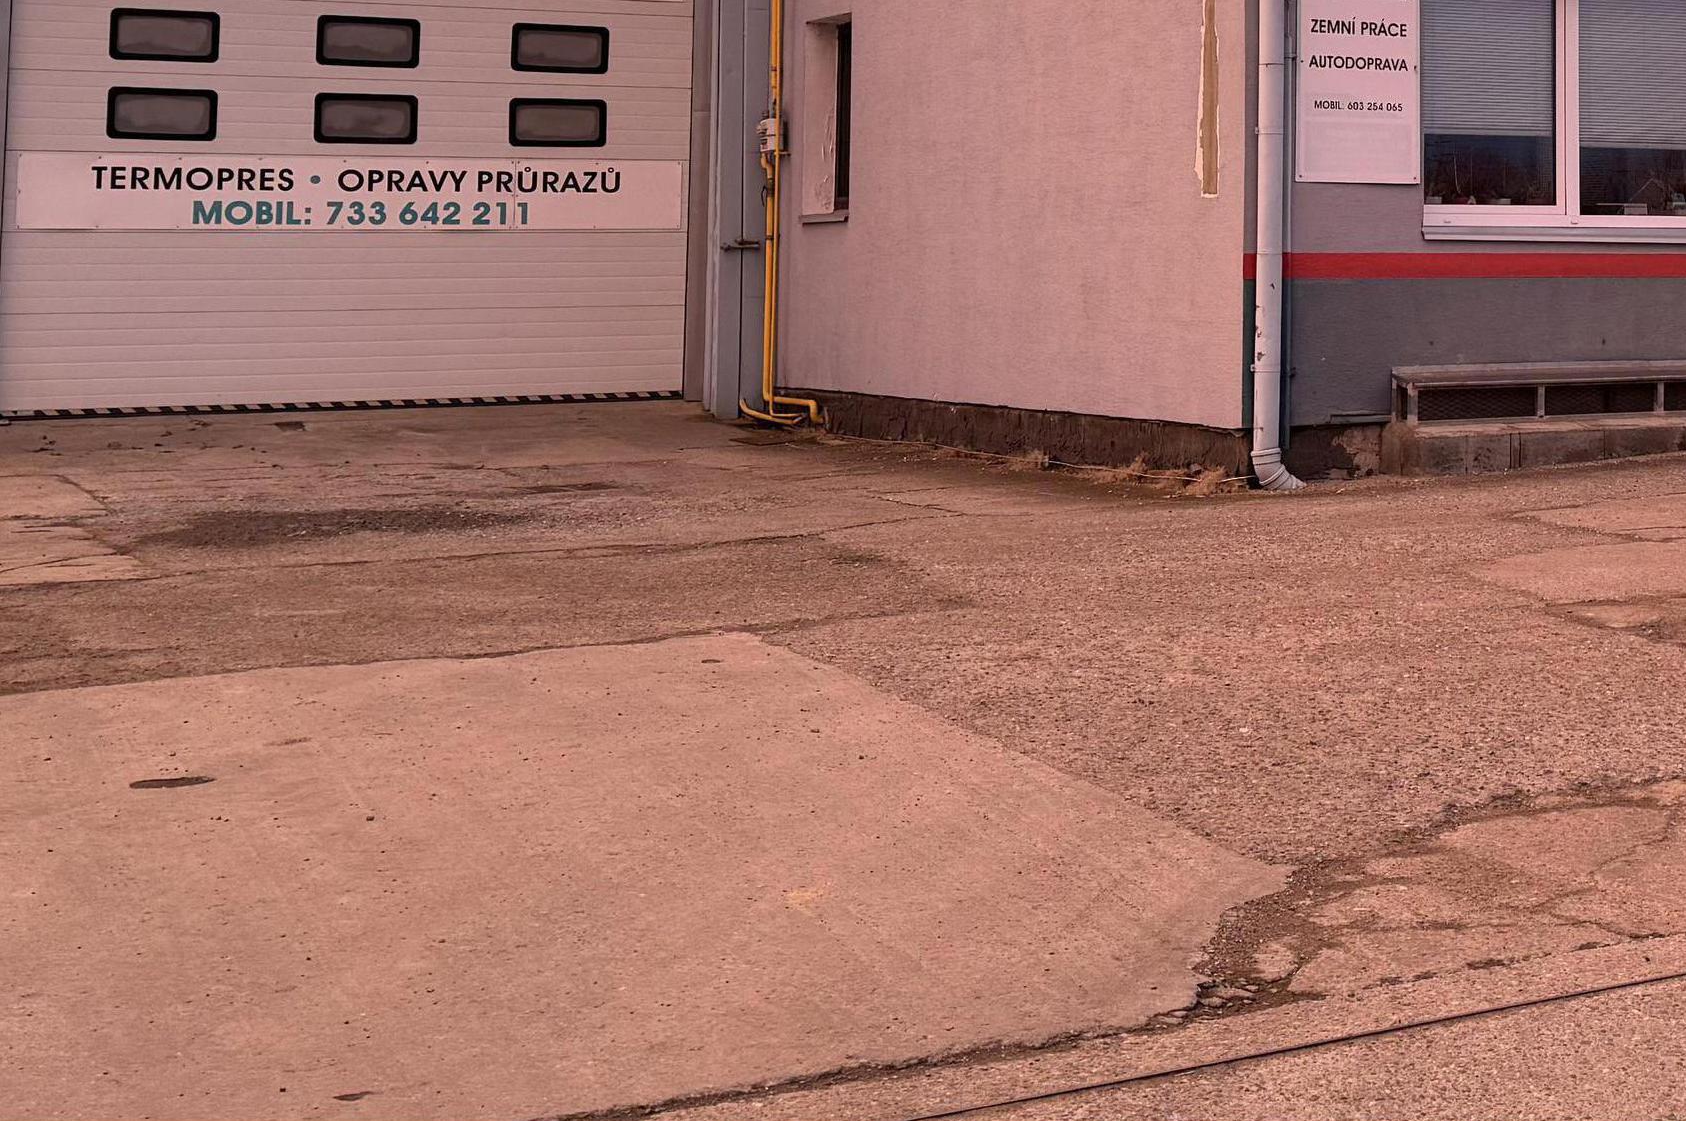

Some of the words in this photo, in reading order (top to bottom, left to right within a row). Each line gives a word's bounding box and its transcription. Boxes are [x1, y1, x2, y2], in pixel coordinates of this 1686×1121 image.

[1310, 16, 1357, 35] ZEMNÍ
[1360, 18, 1408, 38] PRÁCE
[1308, 54, 1409, 72] AUTODOPRAVA
[1347, 101, 1364, 111] 603
[1367, 102, 1384, 111] 254
[1386, 102, 1404, 112] 065
[91, 165, 295, 192] TERMOPRES
[337, 168, 468, 193] OPRAVY
[476, 166, 621, 194] PRŮRAZŮ
[191, 200, 312, 226] MOBIL:
[326, 201, 388, 226] 733
[398, 201, 461, 226] 642
[471, 201, 530, 226] 211
